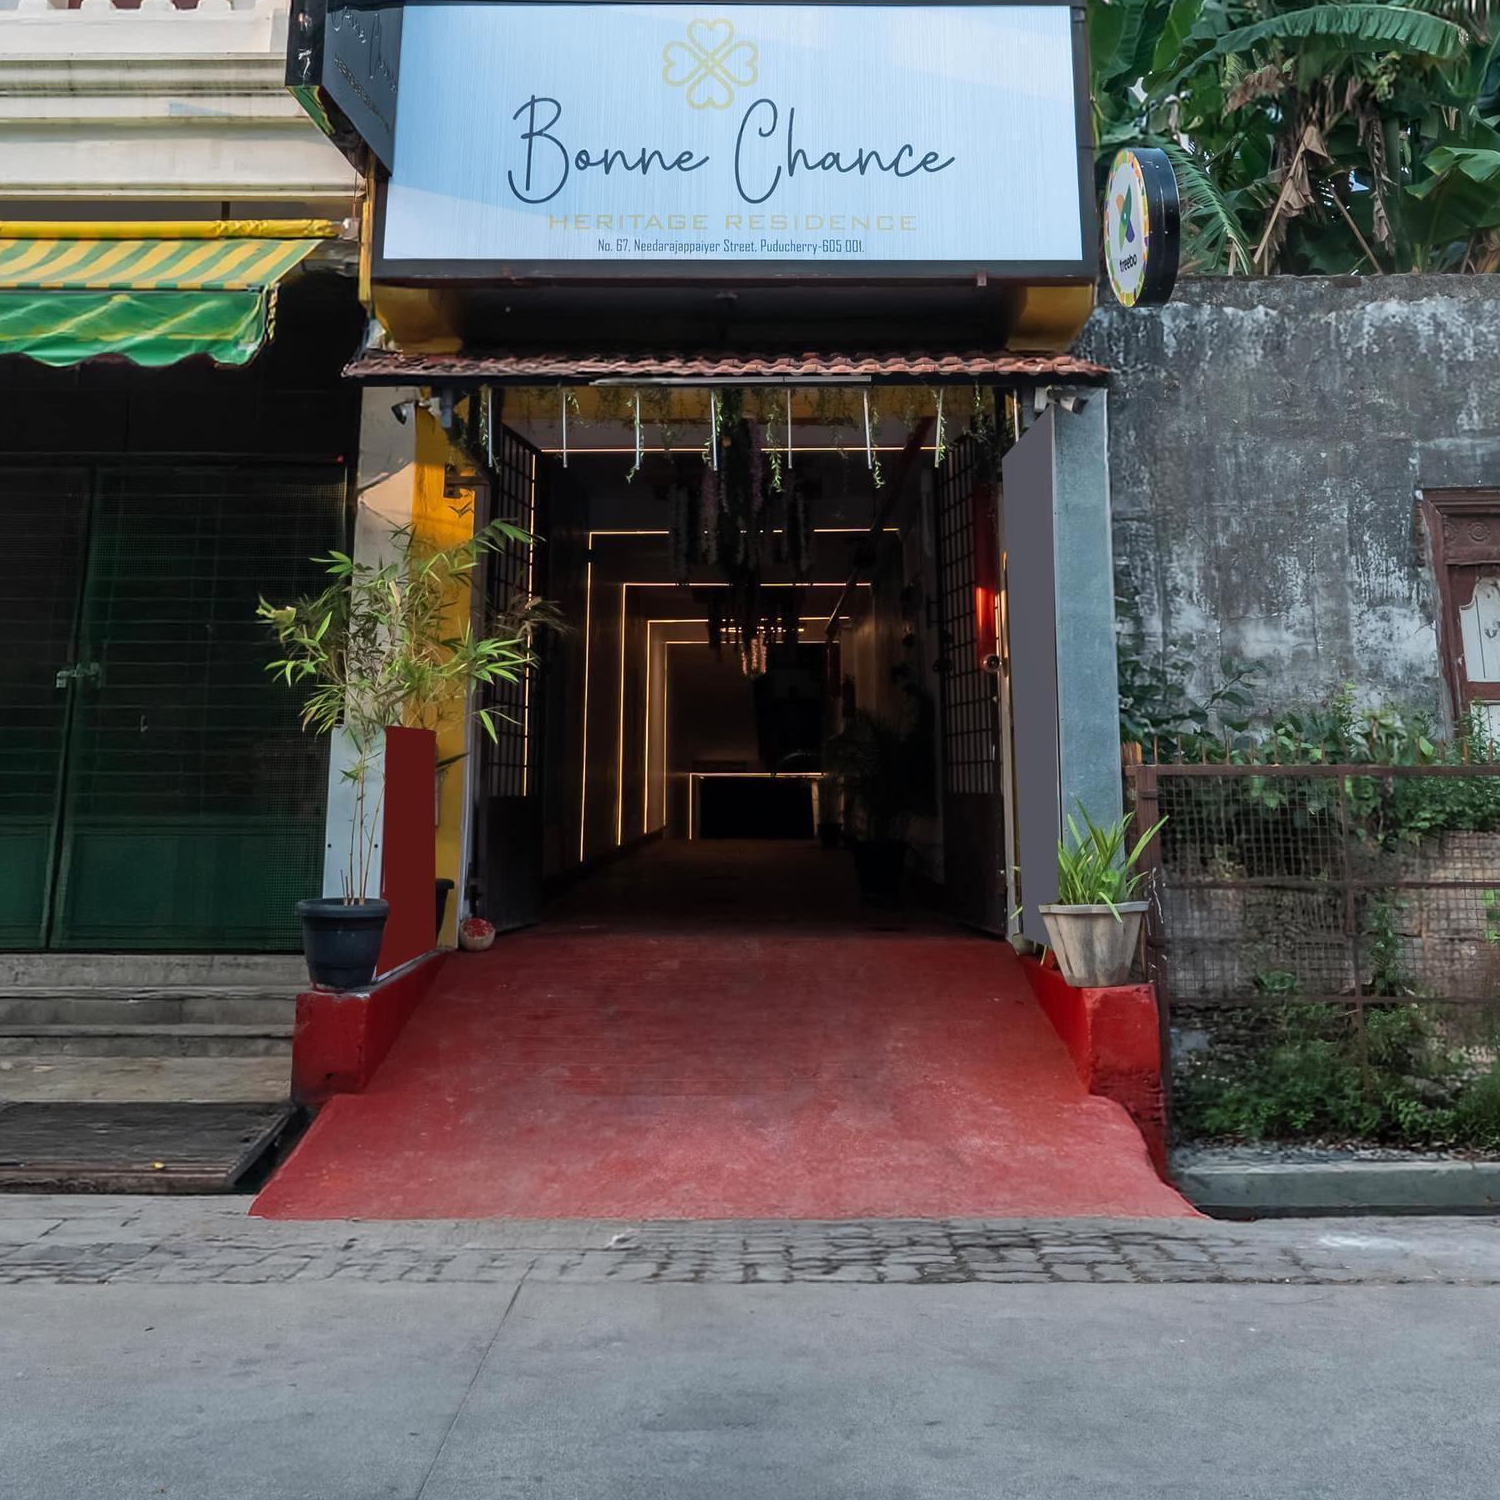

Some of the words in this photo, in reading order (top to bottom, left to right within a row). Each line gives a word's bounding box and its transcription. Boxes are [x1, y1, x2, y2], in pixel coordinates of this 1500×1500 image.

[507, 93, 710, 204] Bonne
[734, 98, 956, 204] Chance
[548, 213, 709, 231] HERITAGE
[725, 213, 917, 232] RESIDENCE
[597, 238, 613, 253] No.
[634, 238, 721, 255] Needarajappaiyer
[1119, 253, 1138, 272] treebo
